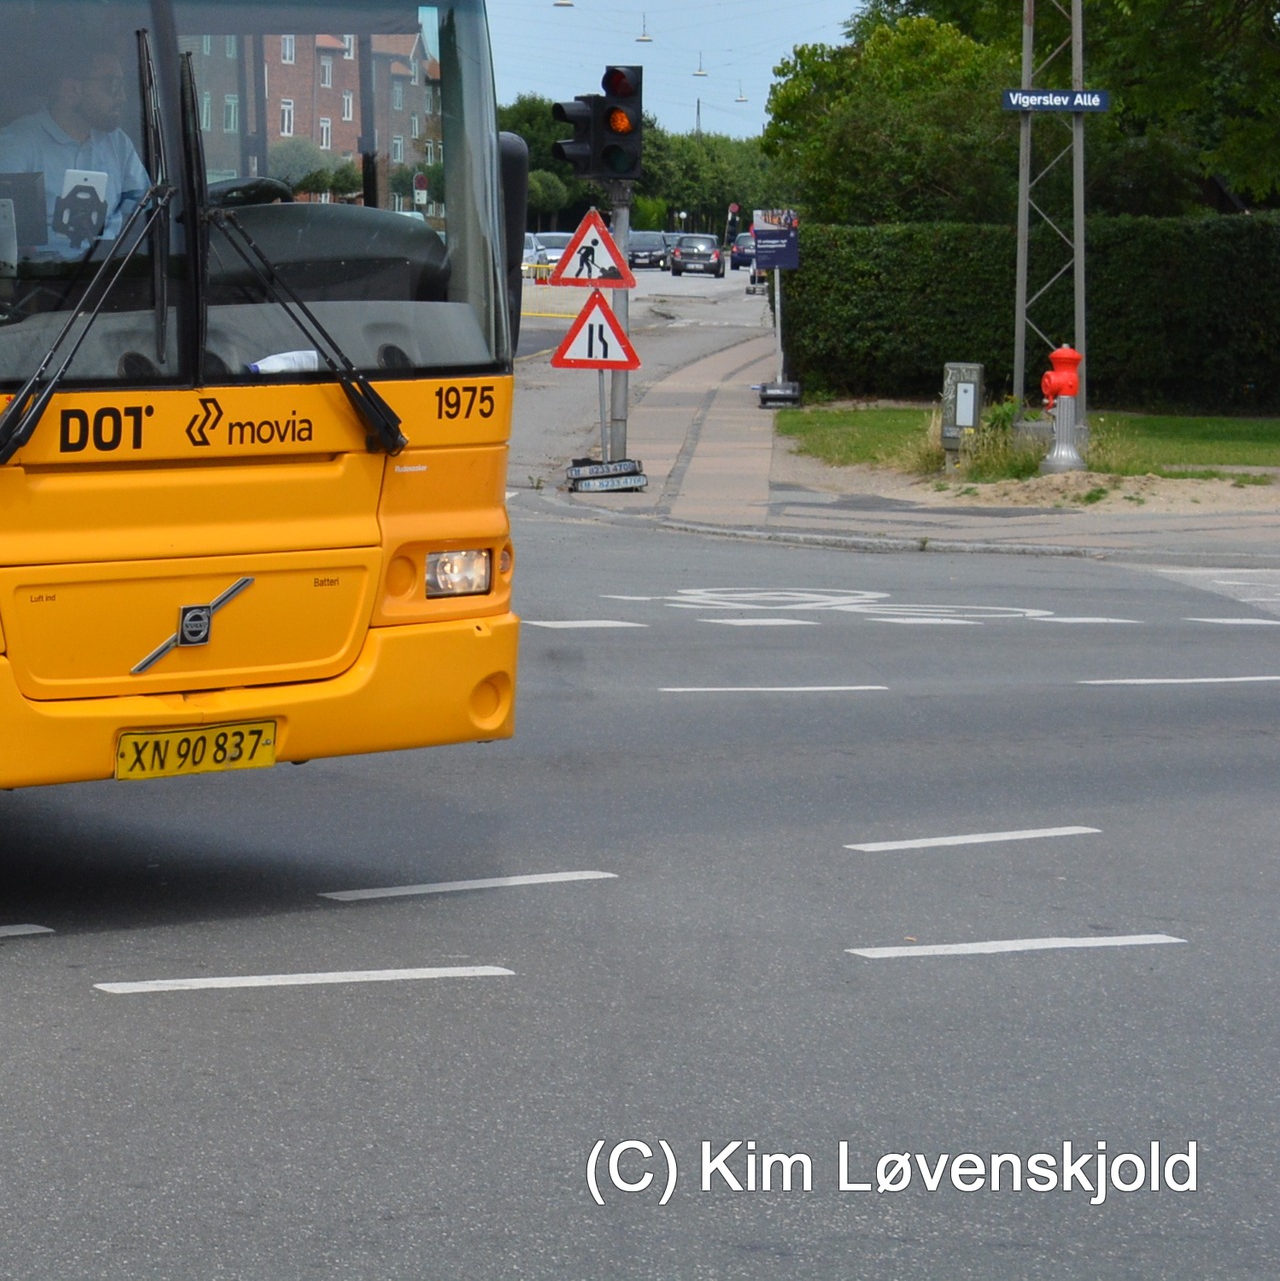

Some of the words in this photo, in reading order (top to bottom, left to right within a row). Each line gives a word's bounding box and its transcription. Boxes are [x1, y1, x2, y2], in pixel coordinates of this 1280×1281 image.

[1009, 92, 1069, 107] Vigerslev
[1073, 93, 1100, 106] Allé
[435, 385, 495, 420] 1975
[60, 406, 143, 453] DOT
[228, 410, 313, 445] movia
[128, 739, 170, 772] XN
[177, 735, 207, 769] 90
[213, 729, 263, 764] 837
